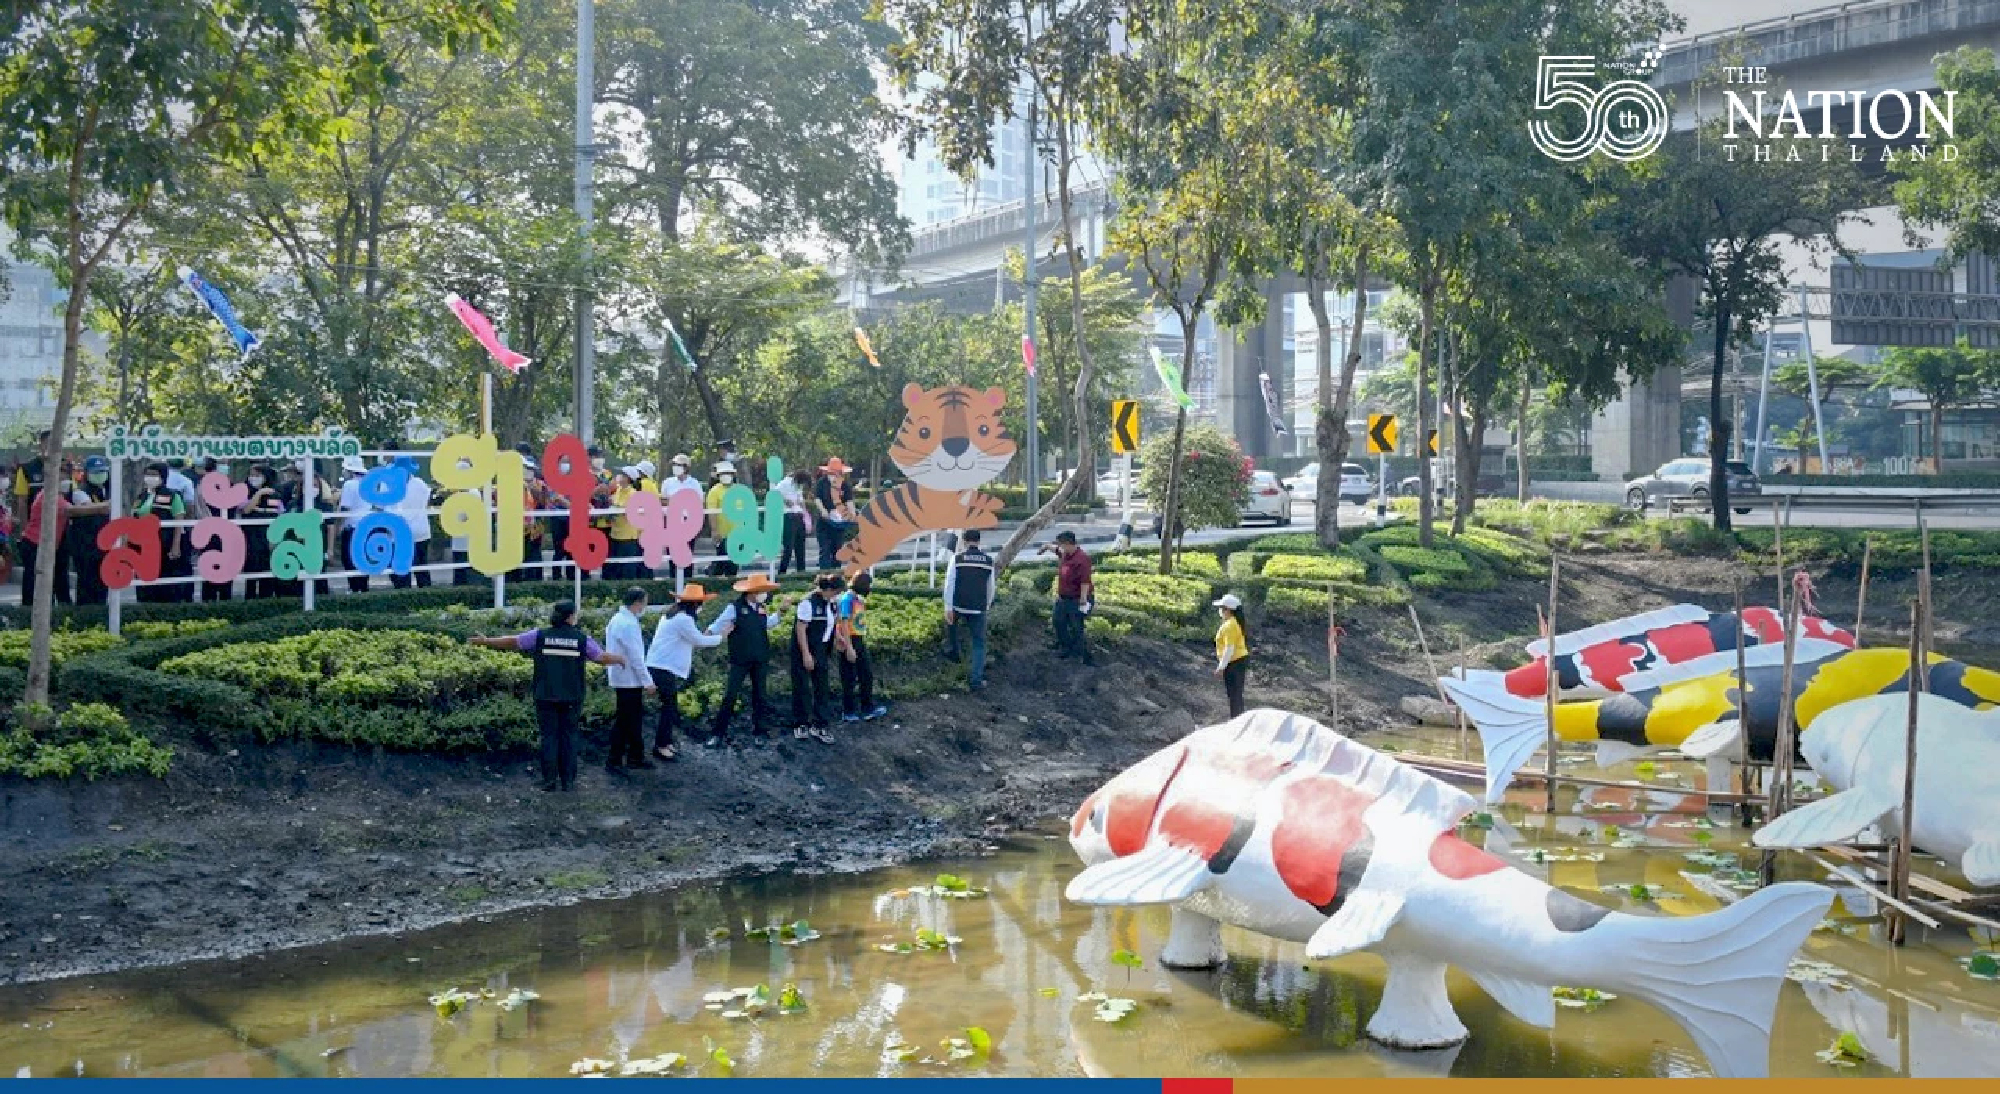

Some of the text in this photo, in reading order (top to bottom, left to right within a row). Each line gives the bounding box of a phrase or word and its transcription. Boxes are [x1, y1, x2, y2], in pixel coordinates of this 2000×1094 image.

[108, 426, 359, 457] สำนักงานเขตบางพลัด
